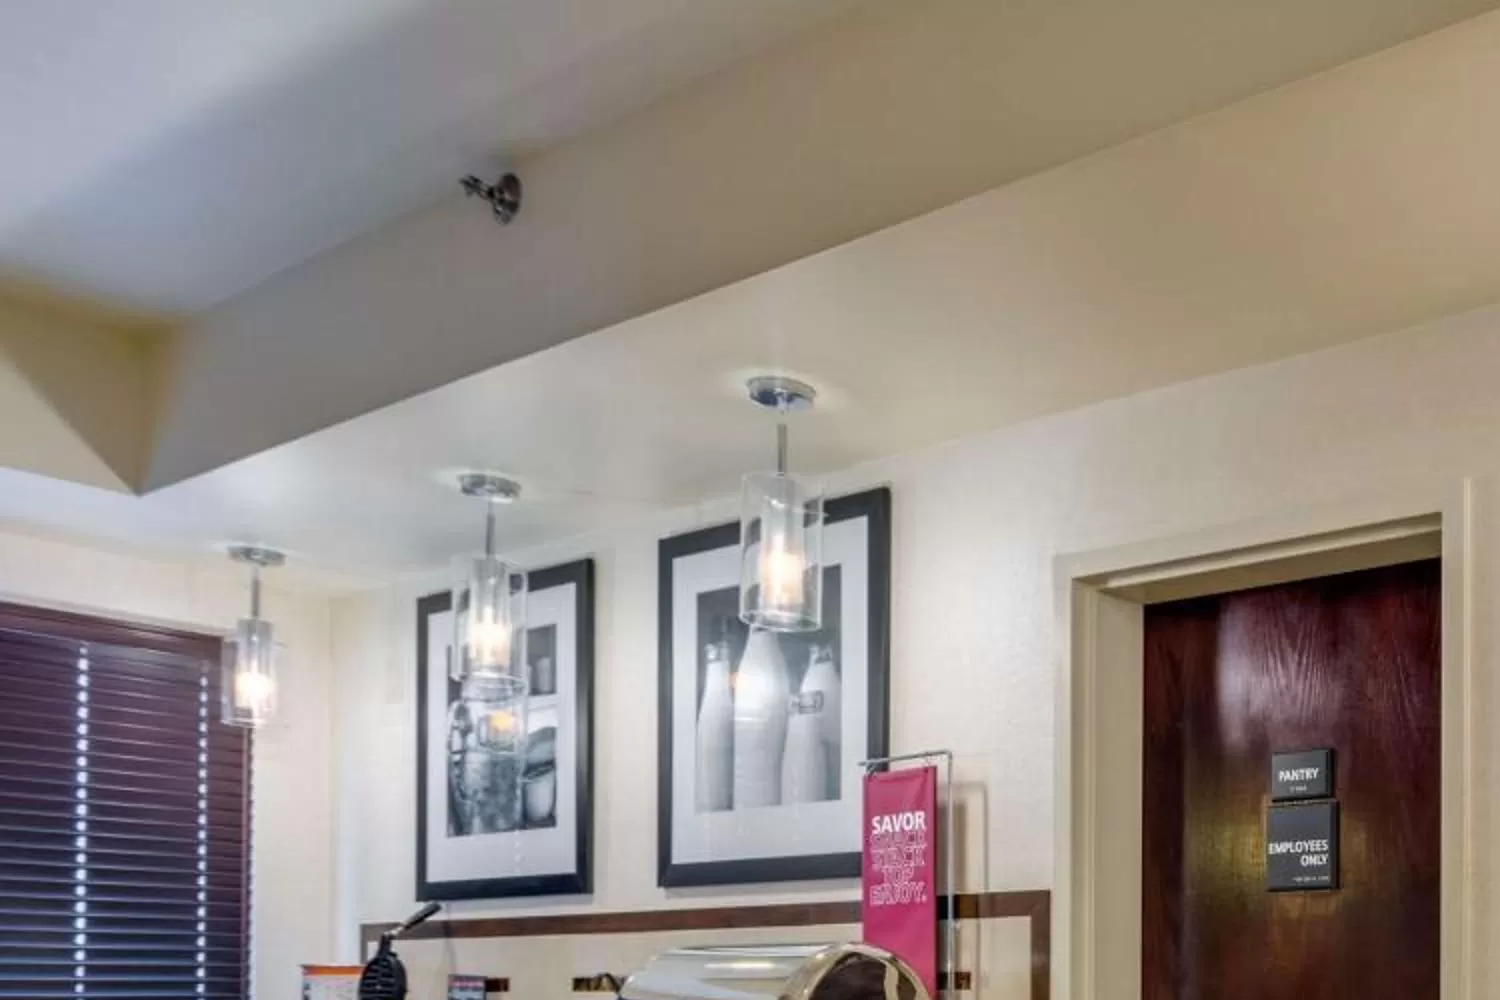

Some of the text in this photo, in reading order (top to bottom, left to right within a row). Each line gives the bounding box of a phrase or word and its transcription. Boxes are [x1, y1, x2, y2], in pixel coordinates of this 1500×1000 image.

[1278, 767, 1319, 783] PANTRY
[871, 810, 927, 835] SAVOR
[1268, 838, 1329, 855] EMPLOYEES
[1300, 853, 1329, 867] ONLY
